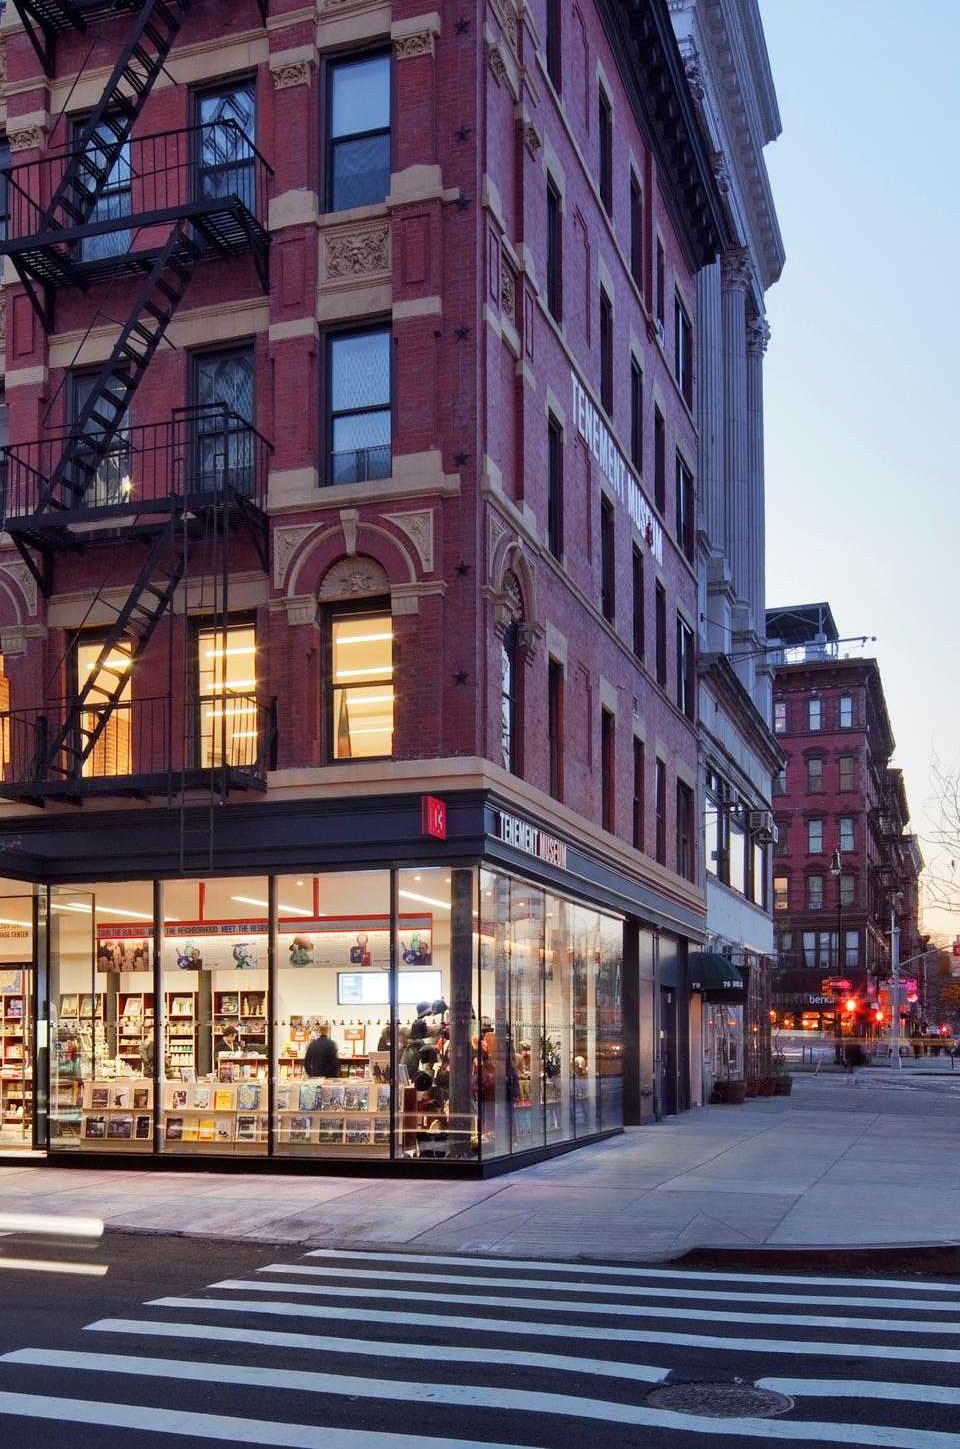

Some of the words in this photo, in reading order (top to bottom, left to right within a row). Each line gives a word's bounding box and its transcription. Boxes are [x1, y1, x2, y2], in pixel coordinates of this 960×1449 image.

[571, 370, 625, 504] TENEMENT
[500, 812, 538, 856] TENEMENT
[540, 832, 566, 869] MUSEUM
[221, 925, 236, 933] MEET
[238, 925, 249, 933] THE
